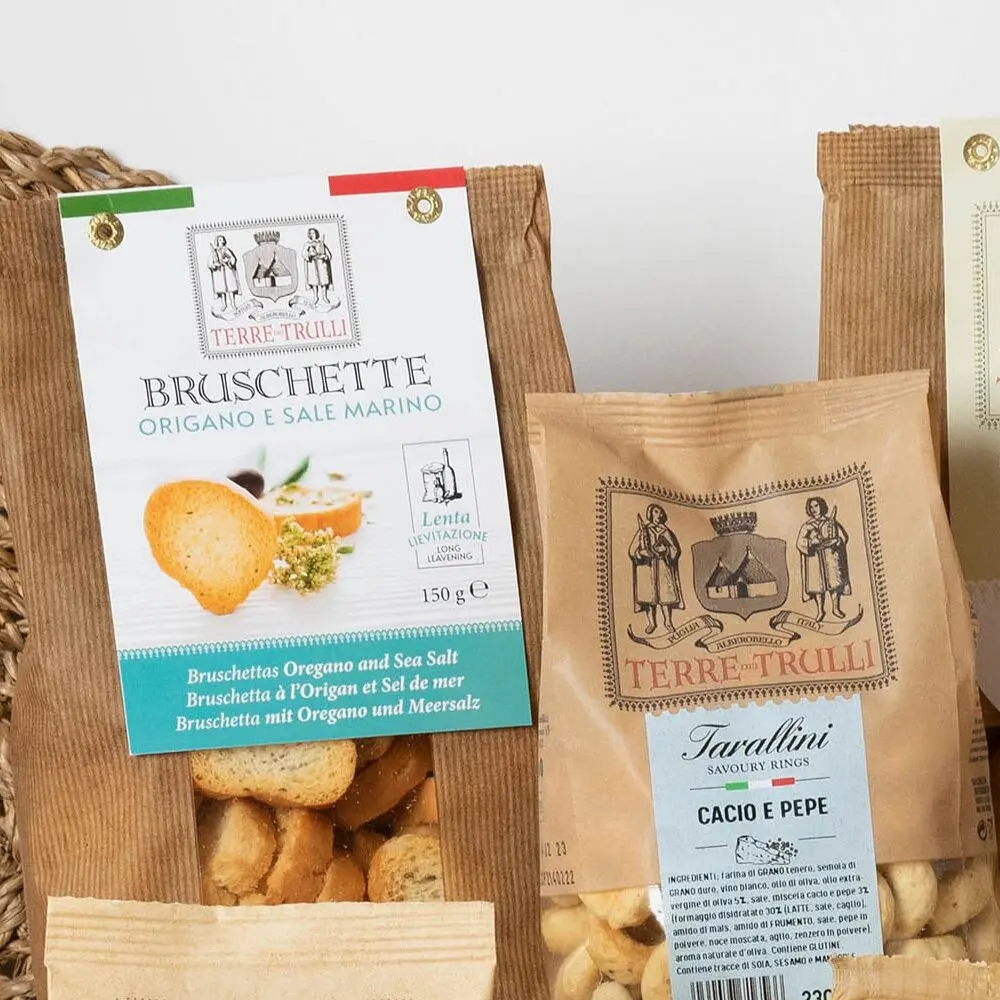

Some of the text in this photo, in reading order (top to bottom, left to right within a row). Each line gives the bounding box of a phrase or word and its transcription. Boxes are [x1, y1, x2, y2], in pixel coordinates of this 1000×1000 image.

[211, 318, 348, 347] TERRE TRULLI
[140, 354, 432, 410] BRUSCHETTE
[139, 394, 442, 436] ORIGANO E SALE MARINO
[422, 511, 471, 527] Lenta
[408, 529, 488, 548] LIEVITAZIONE
[427, 552, 473, 563] LEAVENING
[436, 544, 461, 554] LONG
[422, 586, 450, 603] 150
[715, 635, 783, 651] ALBEROBELLO
[187, 648, 458, 686] Bruschettas Oregano and Sea Salt
[625, 638, 877, 691] TERRE TRULLI
[186, 688, 271, 708] Bruschetta
[275, 685, 285, 702] à
[361, 679, 377, 693] et
[381, 675, 406, 692] Sel
[409, 673, 429, 691] de
[433, 673, 465, 689] mer
[175, 695, 481, 732] Bruschetta mit Oregano und Meersalz
[681, 716, 834, 761] Tarallini
[706, 757, 810, 776] SAVOURY RINGS
[697, 797, 828, 825] CACIO E PEPE
[757, 866, 785, 877] GRANO
[669, 887, 696, 897] GRANO
[720, 884, 738, 893] vino
[774, 957, 807, 968] SESAMO
